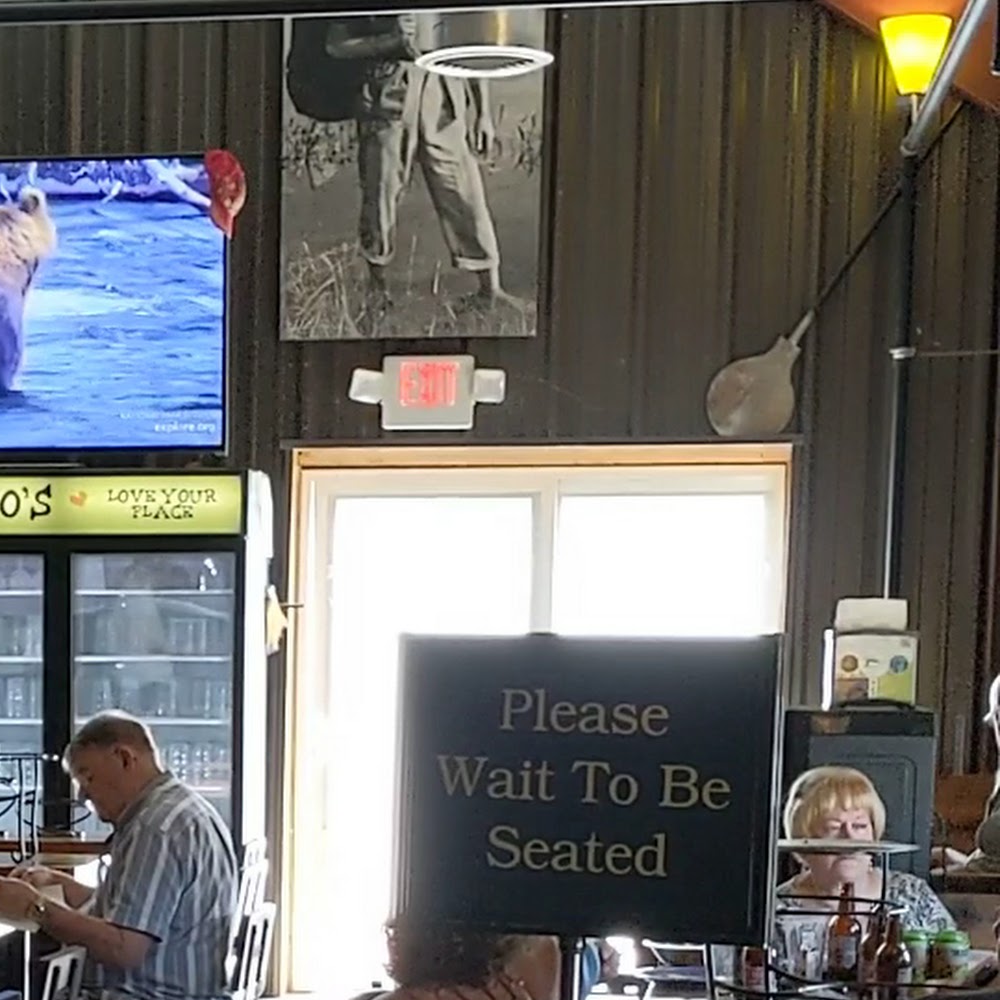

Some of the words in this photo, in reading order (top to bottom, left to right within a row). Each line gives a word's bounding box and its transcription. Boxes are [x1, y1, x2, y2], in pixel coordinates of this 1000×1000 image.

[399, 361, 458, 407] EXIT
[107, 489, 156, 504] LOVE
[159, 488, 216, 504] YOUR
[131, 504, 194, 520] PLACE
[500, 688, 670, 737] Please
[437, 754, 555, 802] Wait
[570, 760, 639, 806] To
[658, 764, 732, 811] Be
[486, 825, 668, 878] Seated
